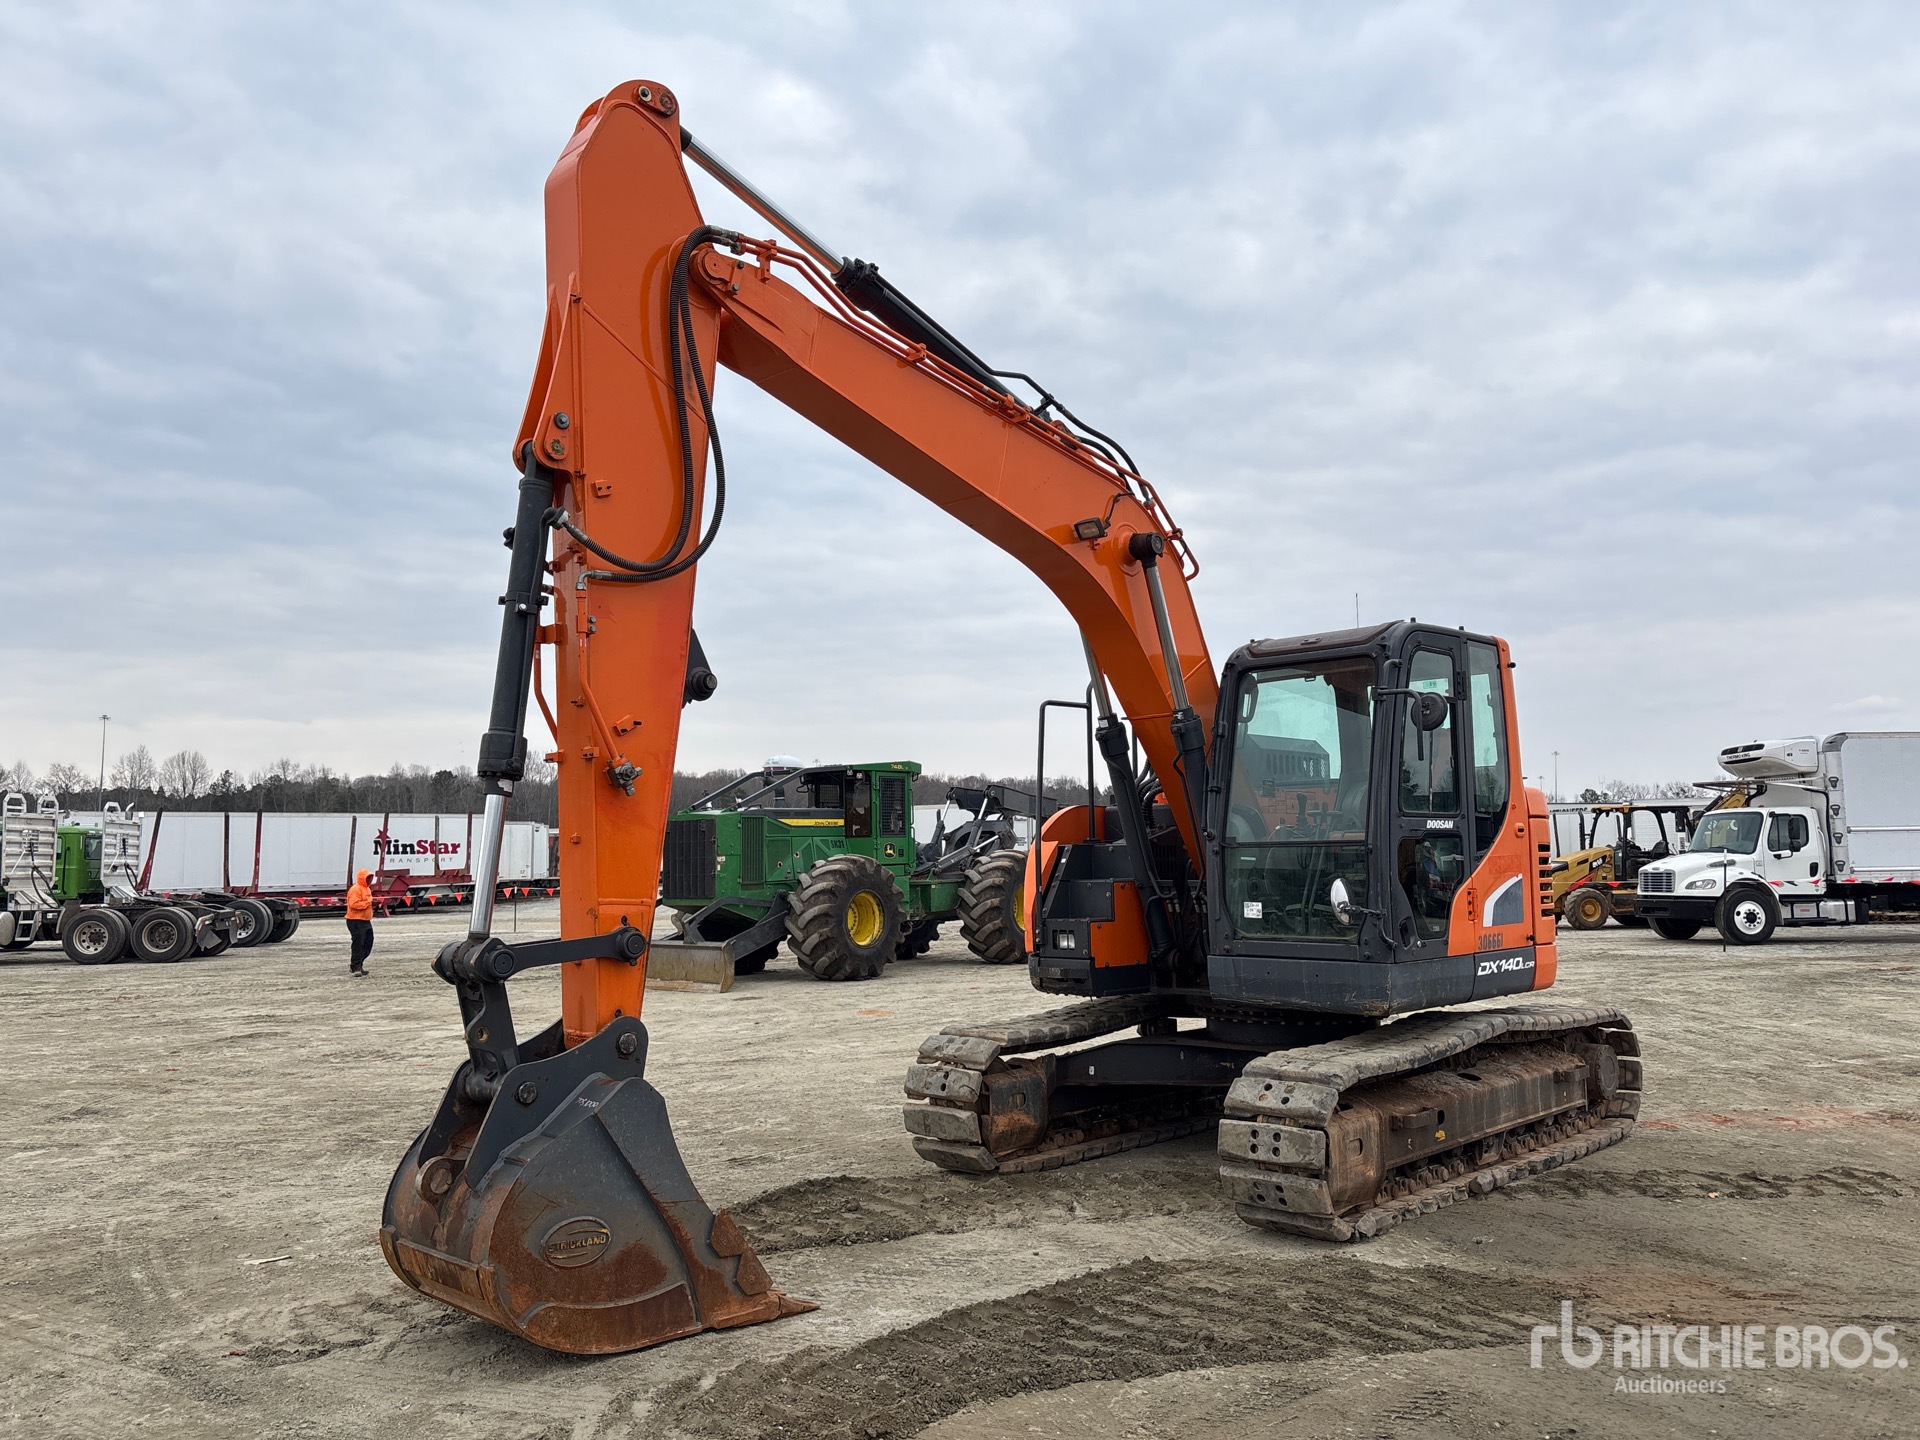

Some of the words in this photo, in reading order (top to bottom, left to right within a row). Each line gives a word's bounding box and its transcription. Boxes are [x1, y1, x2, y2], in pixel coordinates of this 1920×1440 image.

[1426, 820, 1454, 829] DOOSAN
[373, 839, 461, 855] MinStar
[548, 1235, 607, 1252] STRICKLAND
